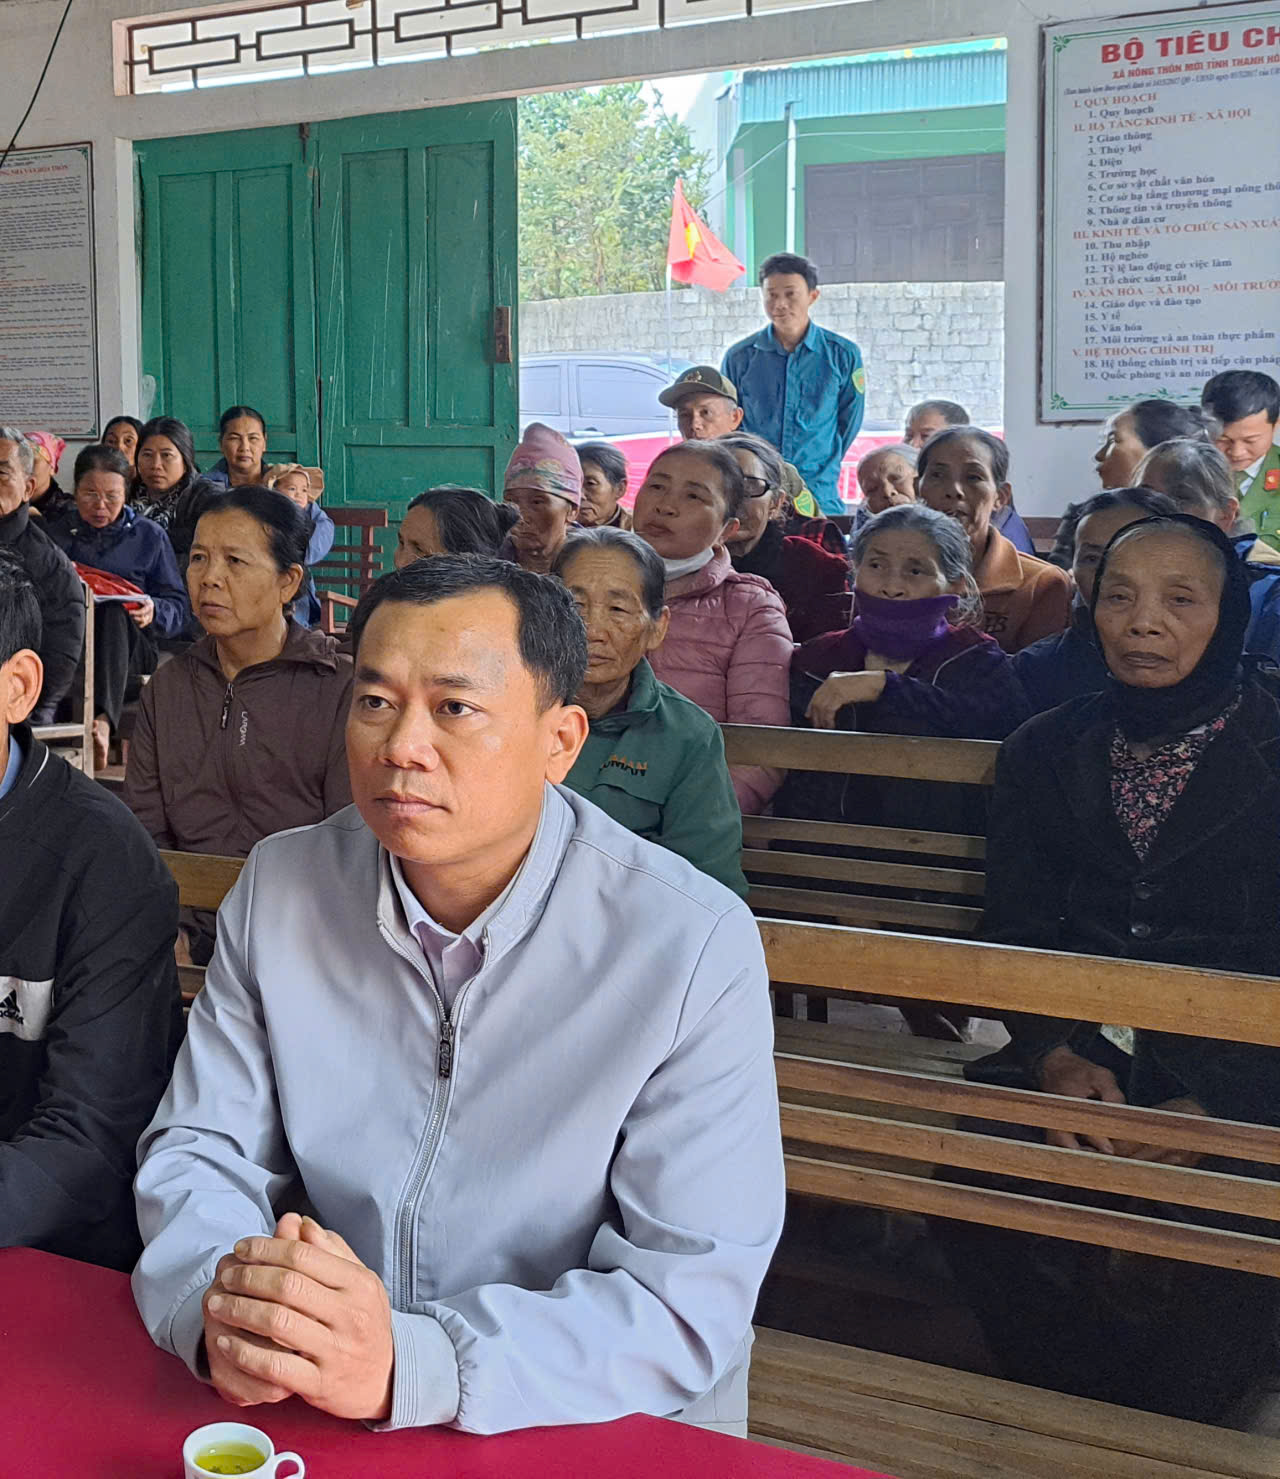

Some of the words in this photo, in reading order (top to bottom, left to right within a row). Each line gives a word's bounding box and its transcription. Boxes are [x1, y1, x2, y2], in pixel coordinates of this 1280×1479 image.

[1101, 37, 1144, 65] BỘ
[1155, 29, 1229, 57] TIÊU
[1100, 109, 1120, 118] Quy
[1124, 105, 1154, 116] hoạch
[1097, 134, 1120, 143] Giao
[1124, 131, 1153, 141] thông
[1140, 168, 1158, 177] học
[1100, 205, 1131, 215] Thông
[1202, 198, 1232, 208] thông
[1252, 216, 1280, 229] XUẤ
[1085, 241, 1099, 250] 10.
[1102, 240, 1122, 249] Thu
[1085, 254, 1099, 262] 11.
[1085, 265, 1099, 274] 12.
[1085, 313, 1099, 321] 15.
[1085, 325, 1099, 333] 16.
[1085, 360, 1098, 369] 18.
